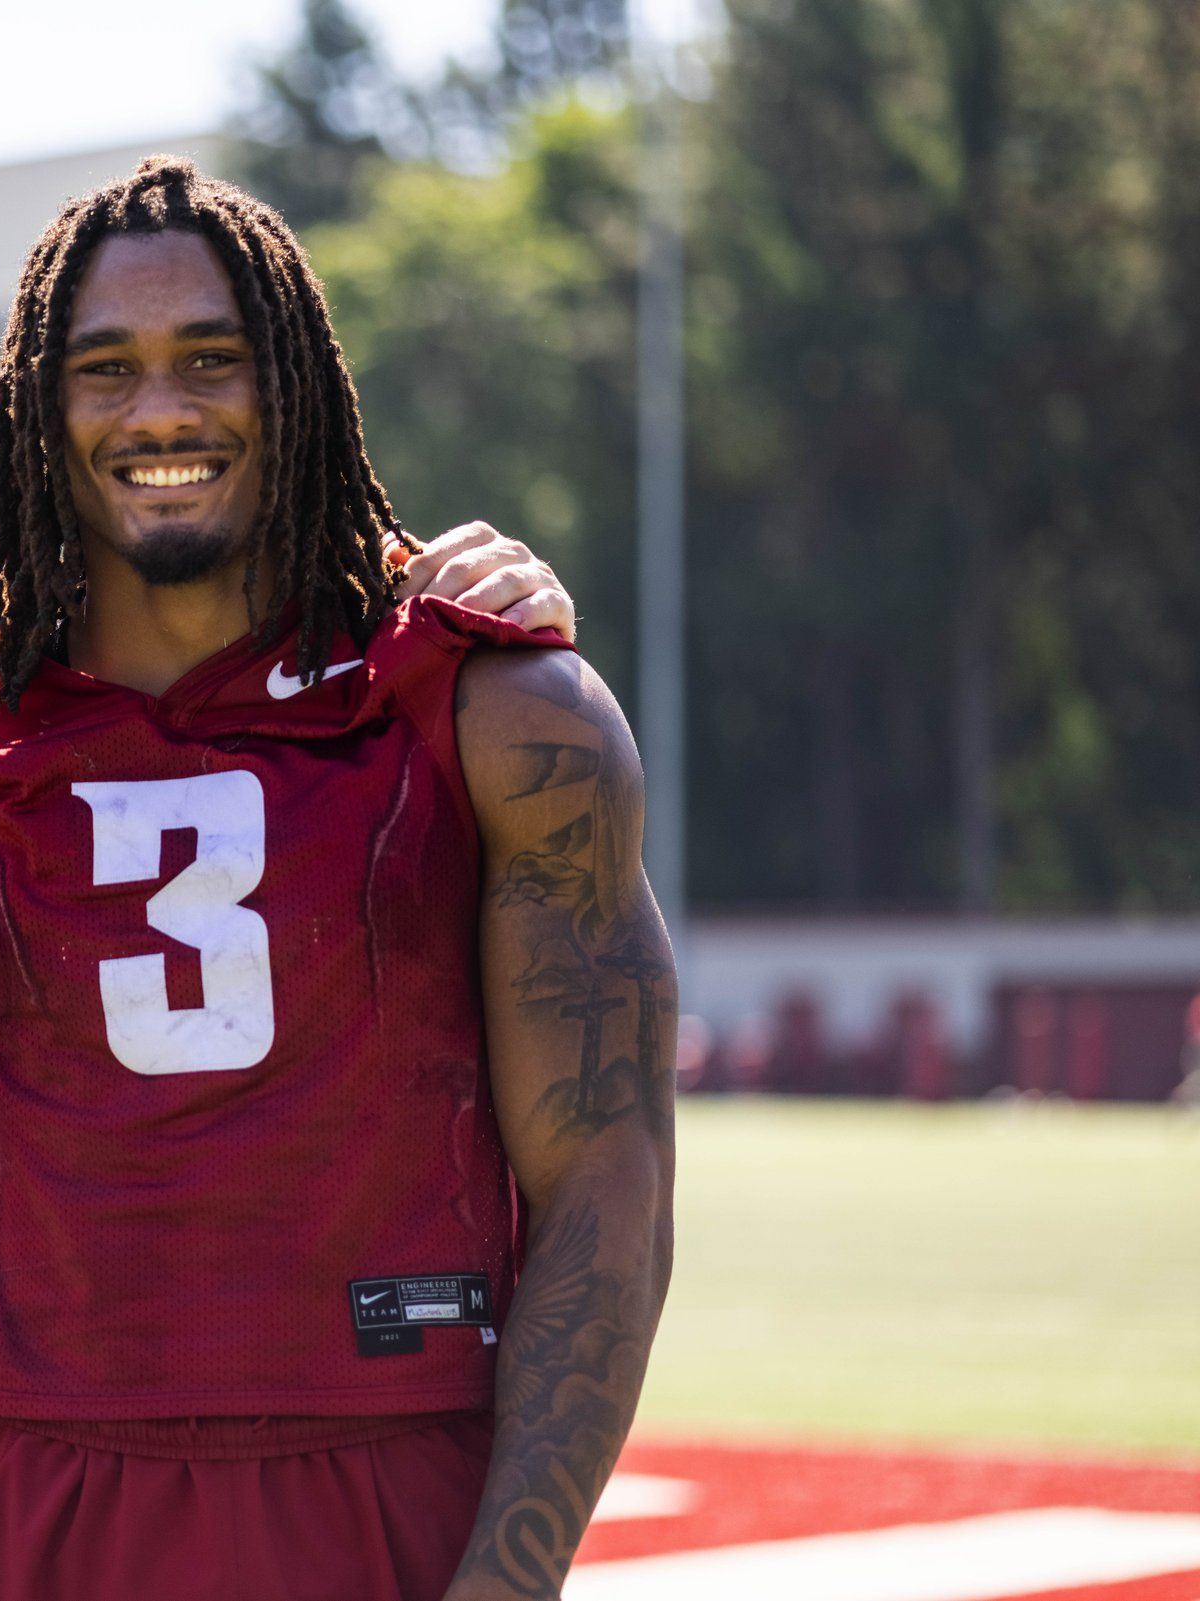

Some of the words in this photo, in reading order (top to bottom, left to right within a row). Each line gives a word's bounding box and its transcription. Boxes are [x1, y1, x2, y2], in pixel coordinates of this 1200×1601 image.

[71, 769, 275, 1075] 3
[401, 1281, 457, 1290] ENGINEERED
[471, 1289, 484, 1310] M
[361, 1308, 399, 1317] TEAM
